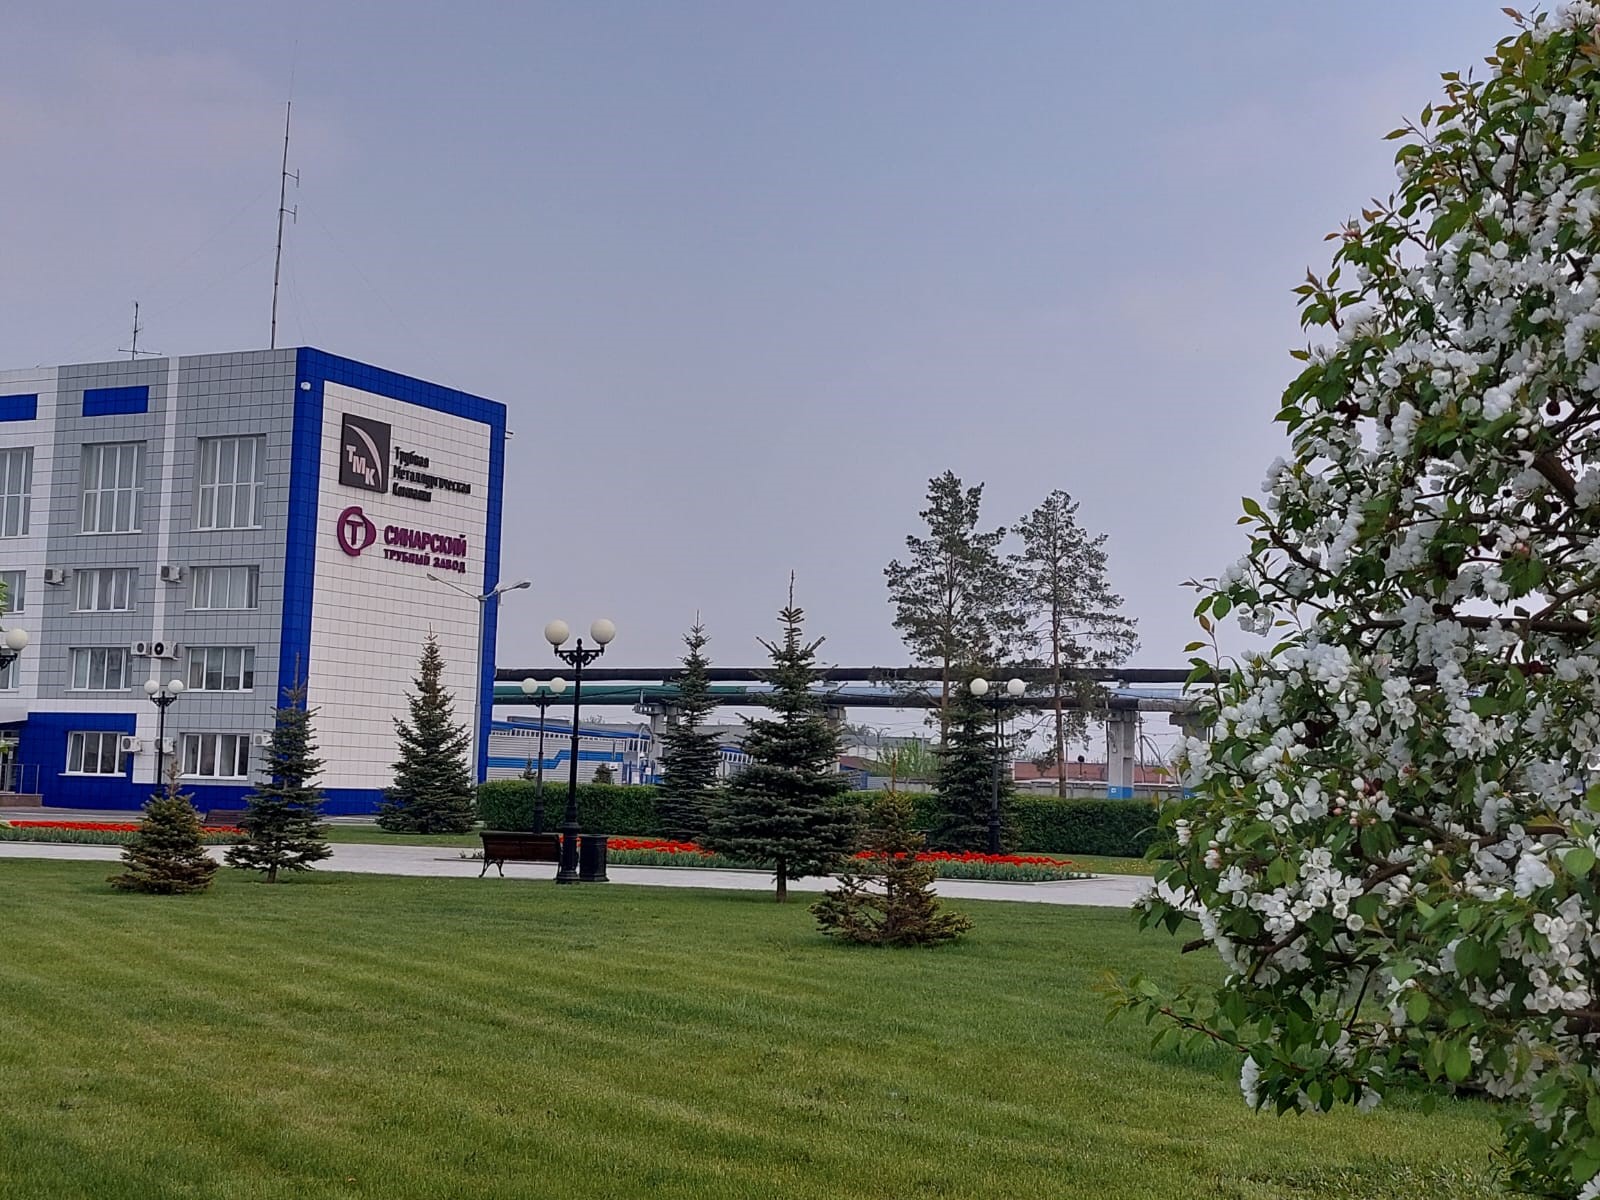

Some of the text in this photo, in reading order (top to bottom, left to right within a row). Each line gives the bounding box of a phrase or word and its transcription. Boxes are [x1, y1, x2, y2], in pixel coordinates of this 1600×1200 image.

[345, 444, 376, 487] ТМК
[394, 446, 430, 468] Трубная
[384, 524, 467, 557] СИНАРСКИЙ
[383, 548, 466, 574] ТРУБНЫЙ ЗАВОД
